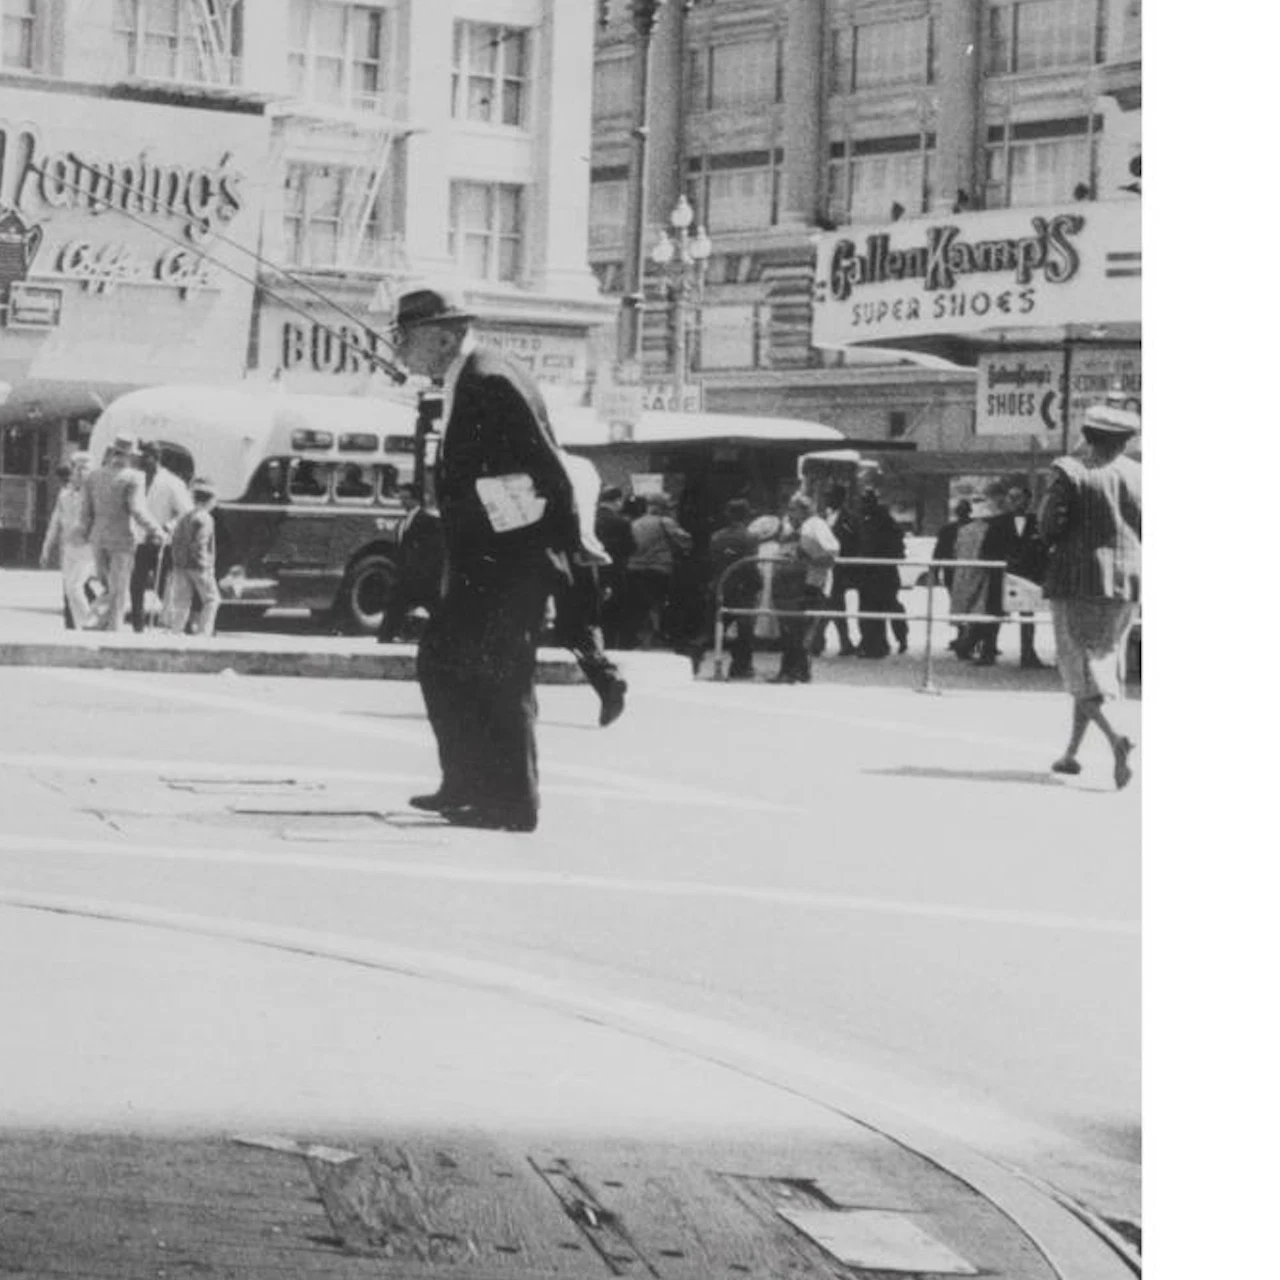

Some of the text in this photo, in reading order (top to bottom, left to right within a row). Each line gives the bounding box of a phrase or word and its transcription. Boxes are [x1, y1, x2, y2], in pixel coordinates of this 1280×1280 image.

[850, 288, 1036, 327] SUPER SHOES
[987, 393, 1036, 417] SHOES
